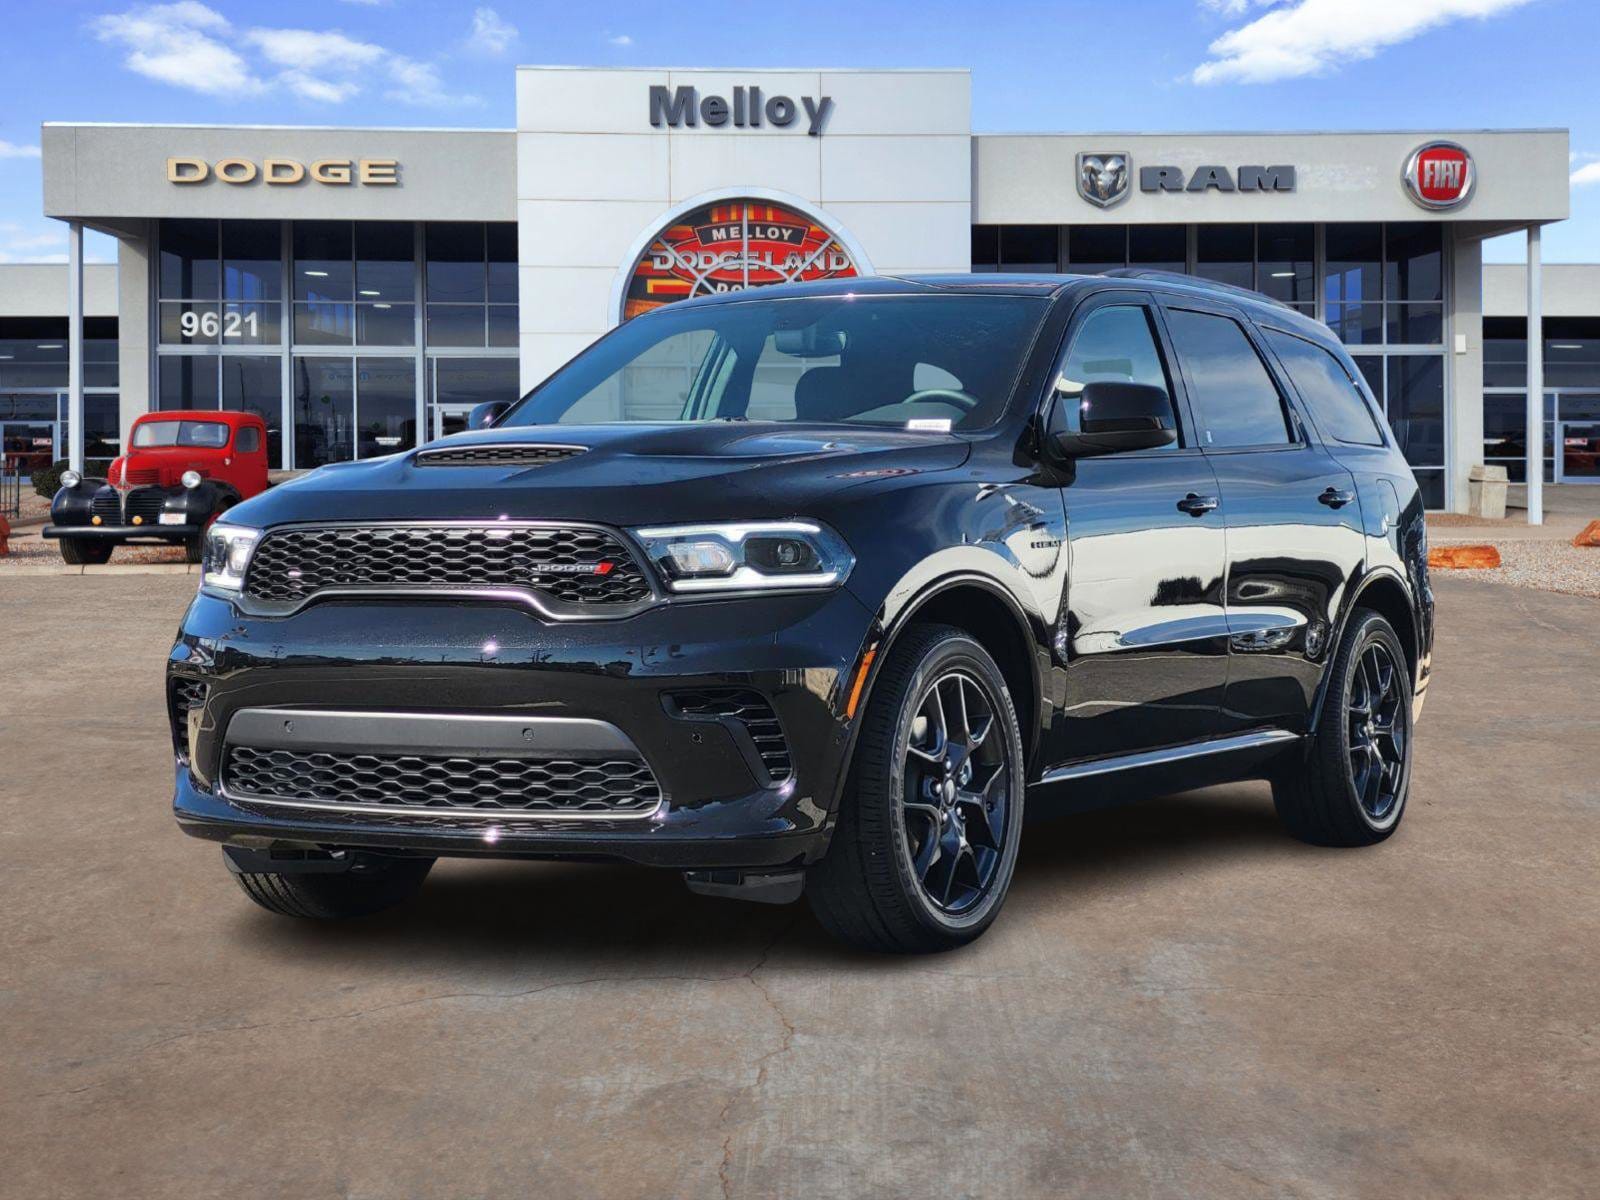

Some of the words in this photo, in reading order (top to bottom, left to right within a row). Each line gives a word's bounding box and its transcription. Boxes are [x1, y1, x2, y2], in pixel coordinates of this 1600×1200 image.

[649, 85, 832, 136] Melloy
[167, 158, 398, 185] DODGE
[1140, 165, 1296, 193] RAM
[1423, 159, 1463, 188] FIAT
[180, 312, 258, 337] 9621
